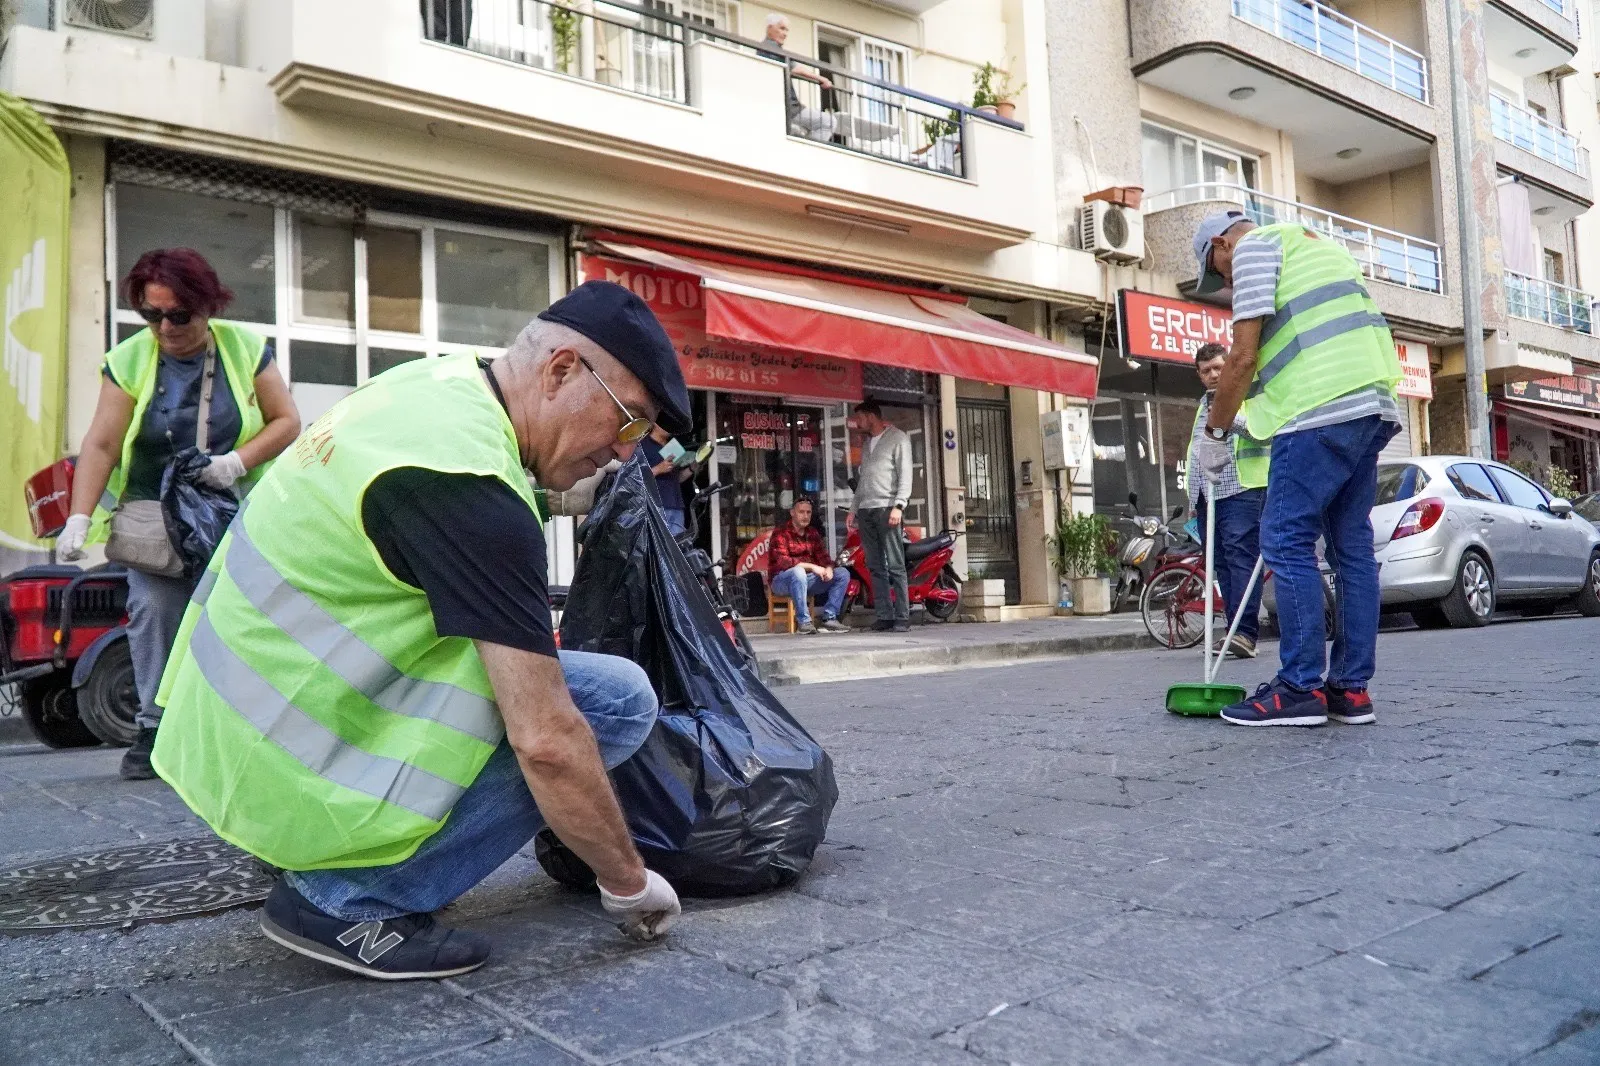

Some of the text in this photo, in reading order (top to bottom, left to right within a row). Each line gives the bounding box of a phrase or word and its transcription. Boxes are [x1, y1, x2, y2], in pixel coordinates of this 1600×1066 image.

[605, 267, 707, 309] MOTO
[697, 345, 746, 361] Bisiklet
[1165, 336, 1180, 353] EL
[706, 364, 735, 381] 302
[762, 371, 778, 386] 55
[336, 920, 405, 965] N
